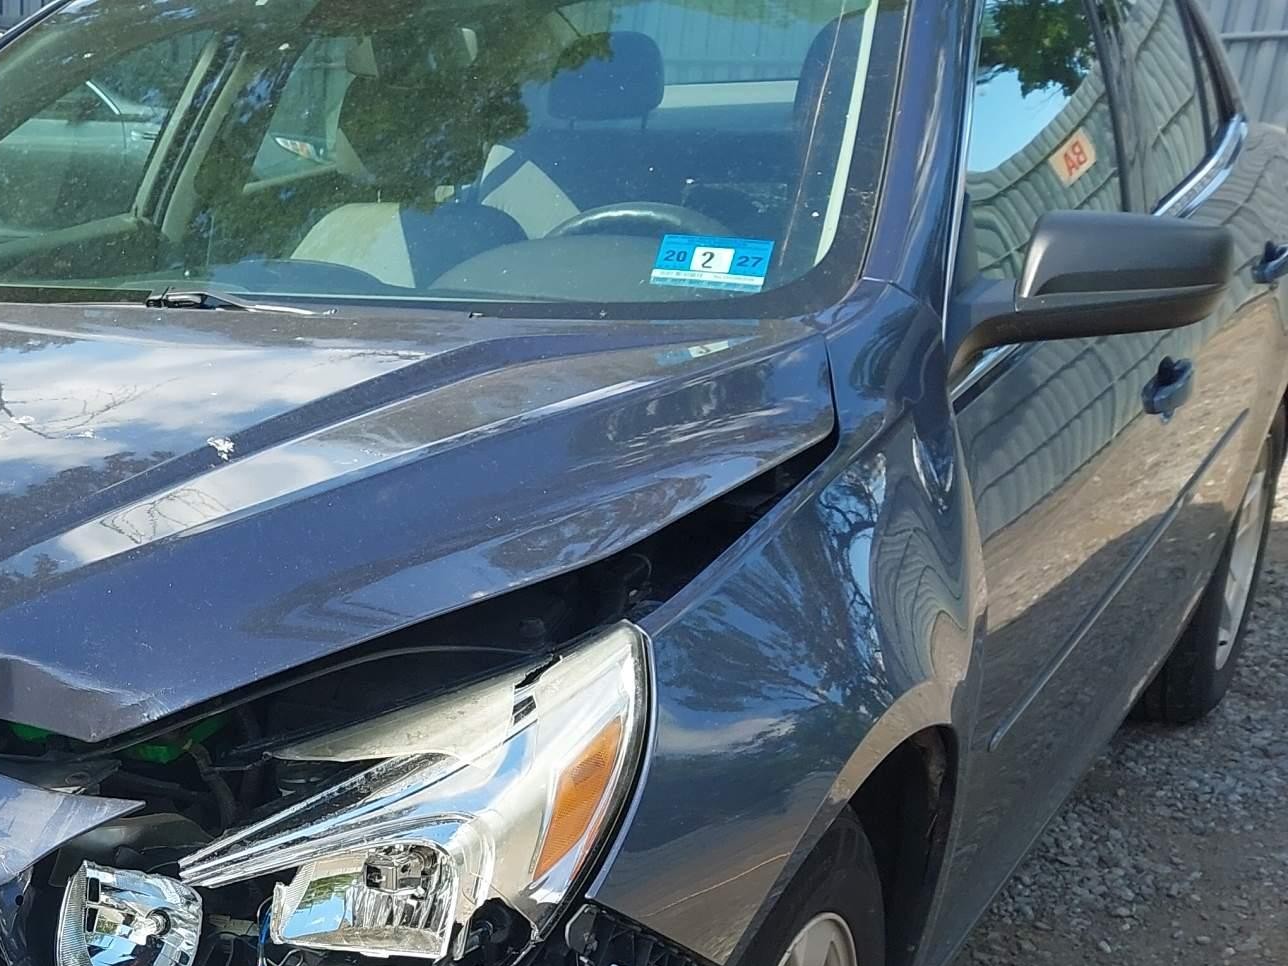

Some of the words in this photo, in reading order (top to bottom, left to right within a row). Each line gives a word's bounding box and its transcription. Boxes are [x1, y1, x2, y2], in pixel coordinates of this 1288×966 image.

[663, 249, 688, 263] 20
[700, 251, 715, 269] 2
[736, 255, 763, 268] 27
